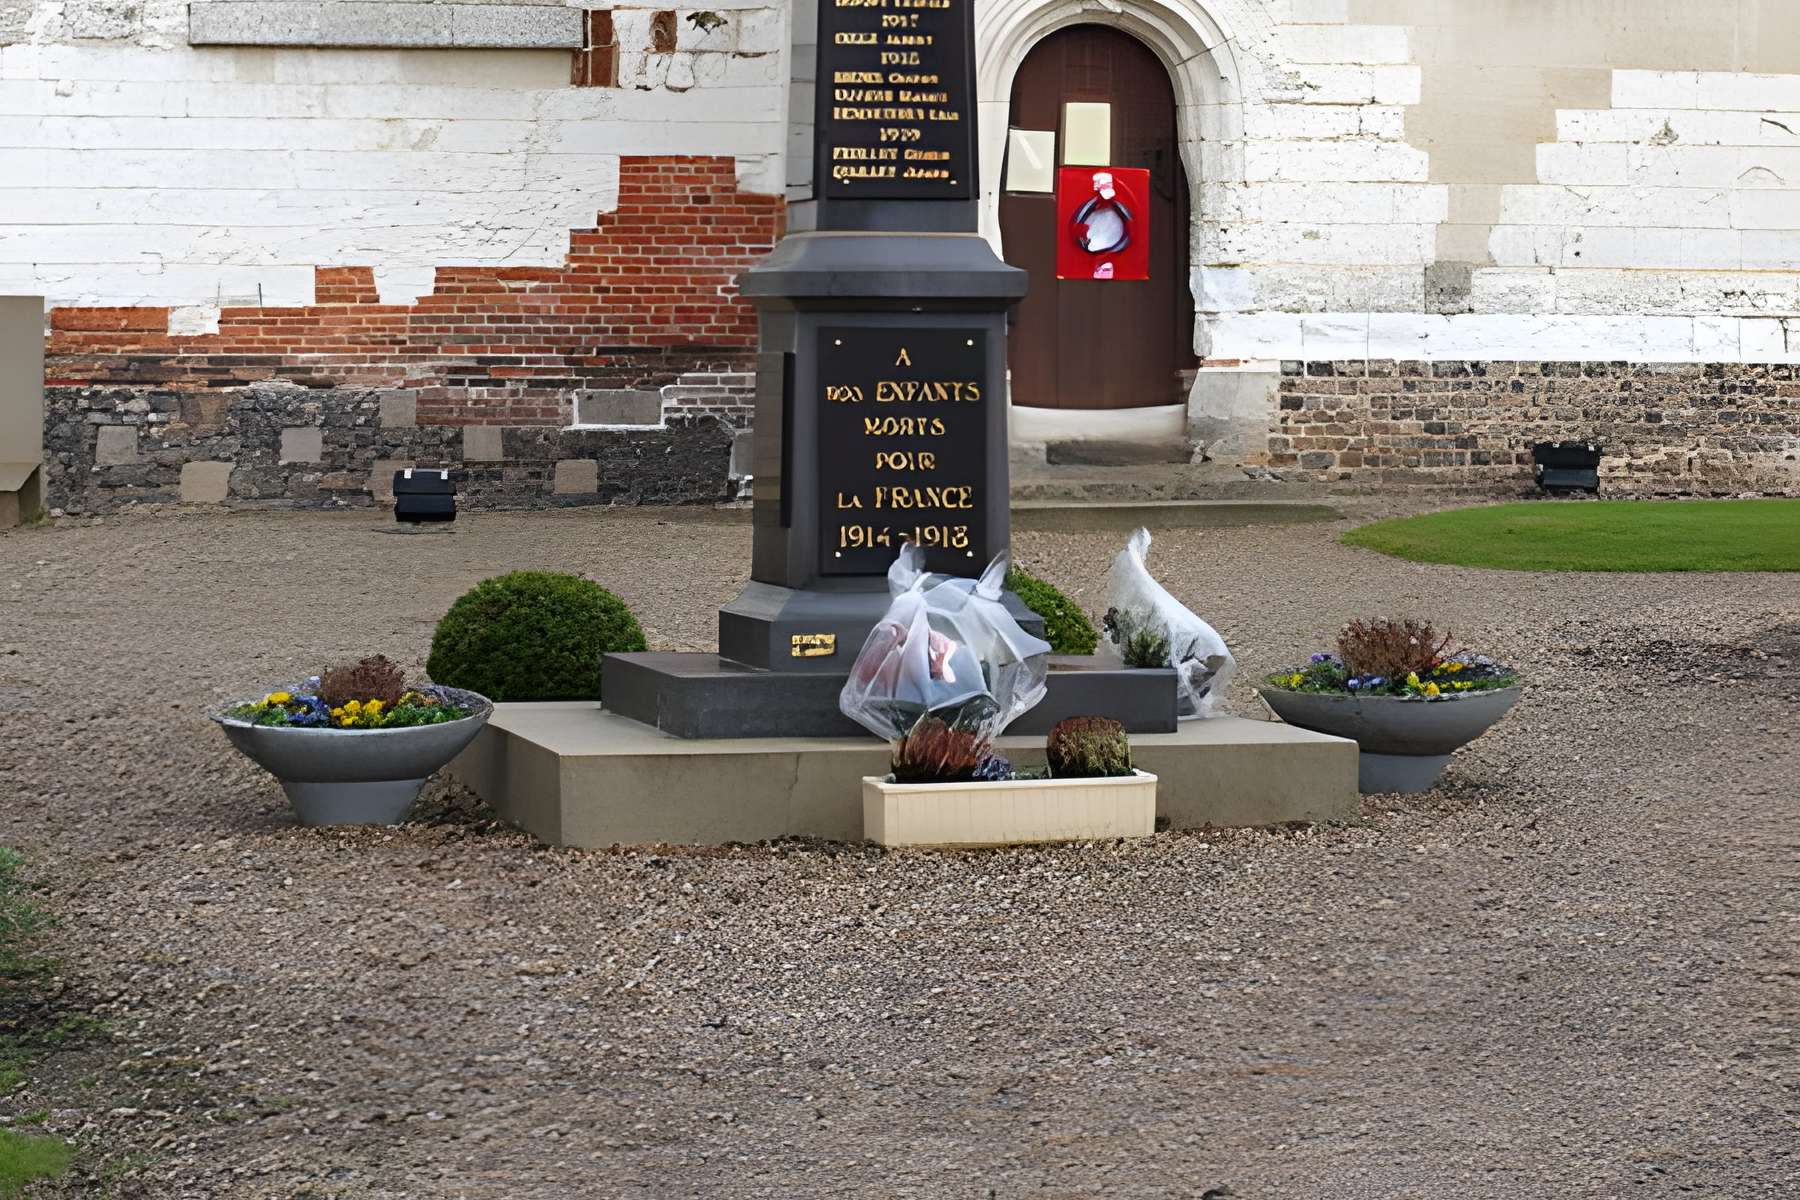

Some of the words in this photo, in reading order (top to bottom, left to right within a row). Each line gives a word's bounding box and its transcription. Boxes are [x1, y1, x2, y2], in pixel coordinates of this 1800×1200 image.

[895, 347, 912, 367] A
[876, 380, 981, 402] ENFANTS
[863, 416, 946, 436] MORTS
[874, 485, 974, 509] FRANCE
